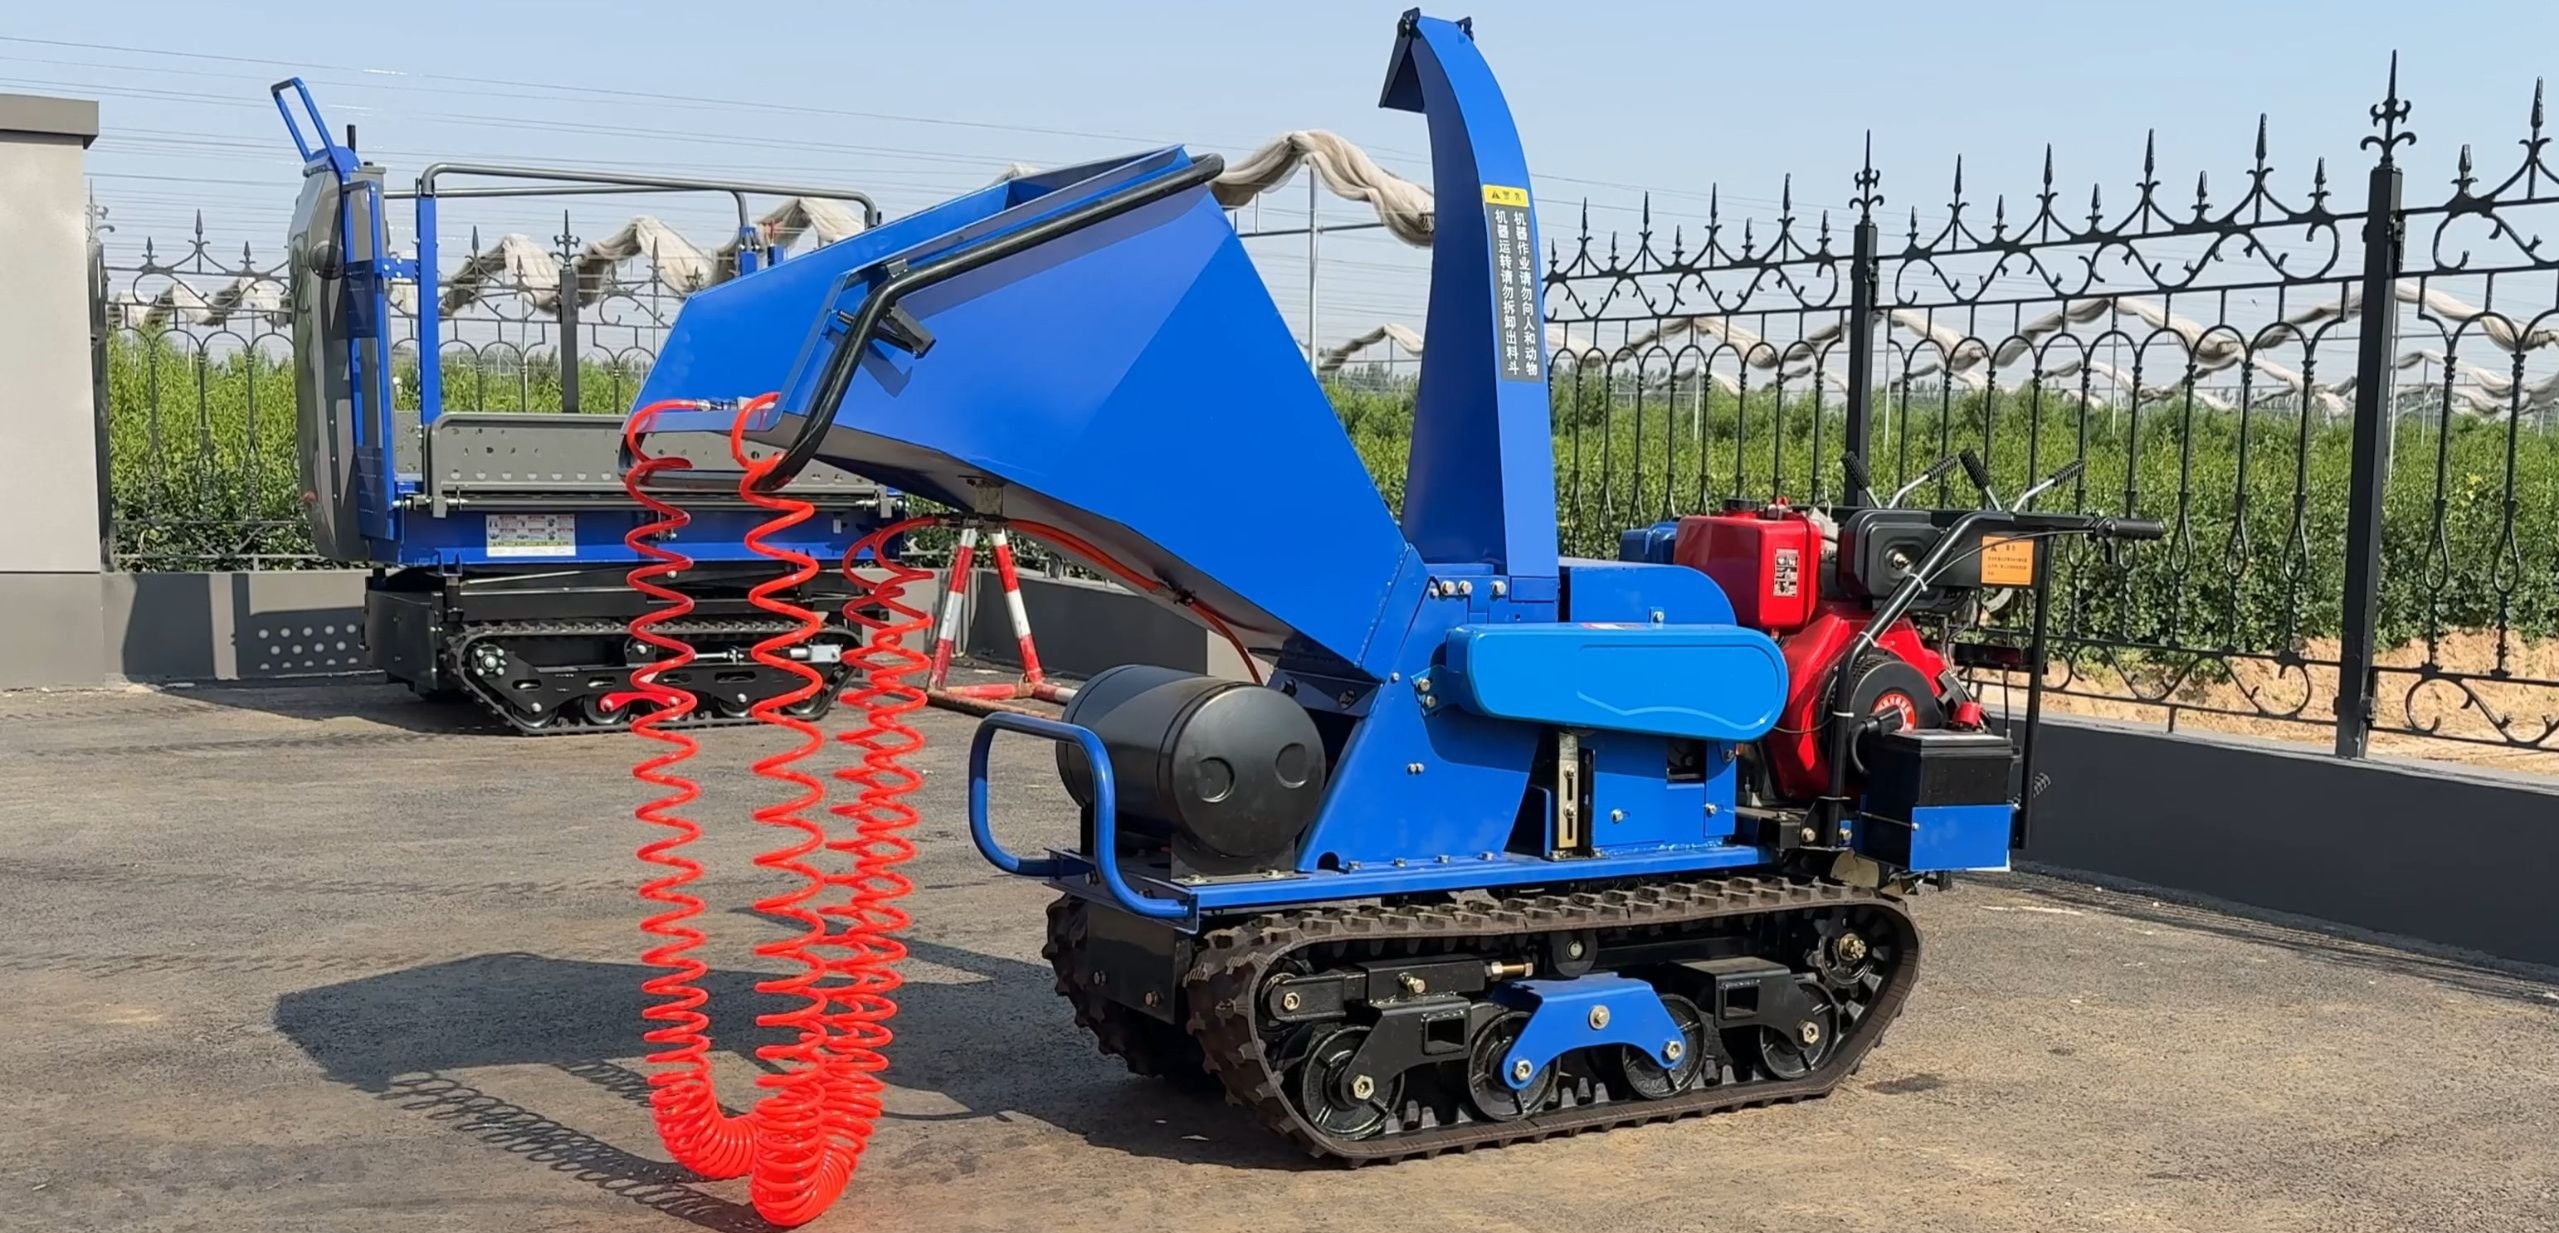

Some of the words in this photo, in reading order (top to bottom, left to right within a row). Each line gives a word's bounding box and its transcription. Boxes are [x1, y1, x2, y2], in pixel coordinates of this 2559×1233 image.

[1514, 210, 1538, 376] 机器作业请勿向人和动物
